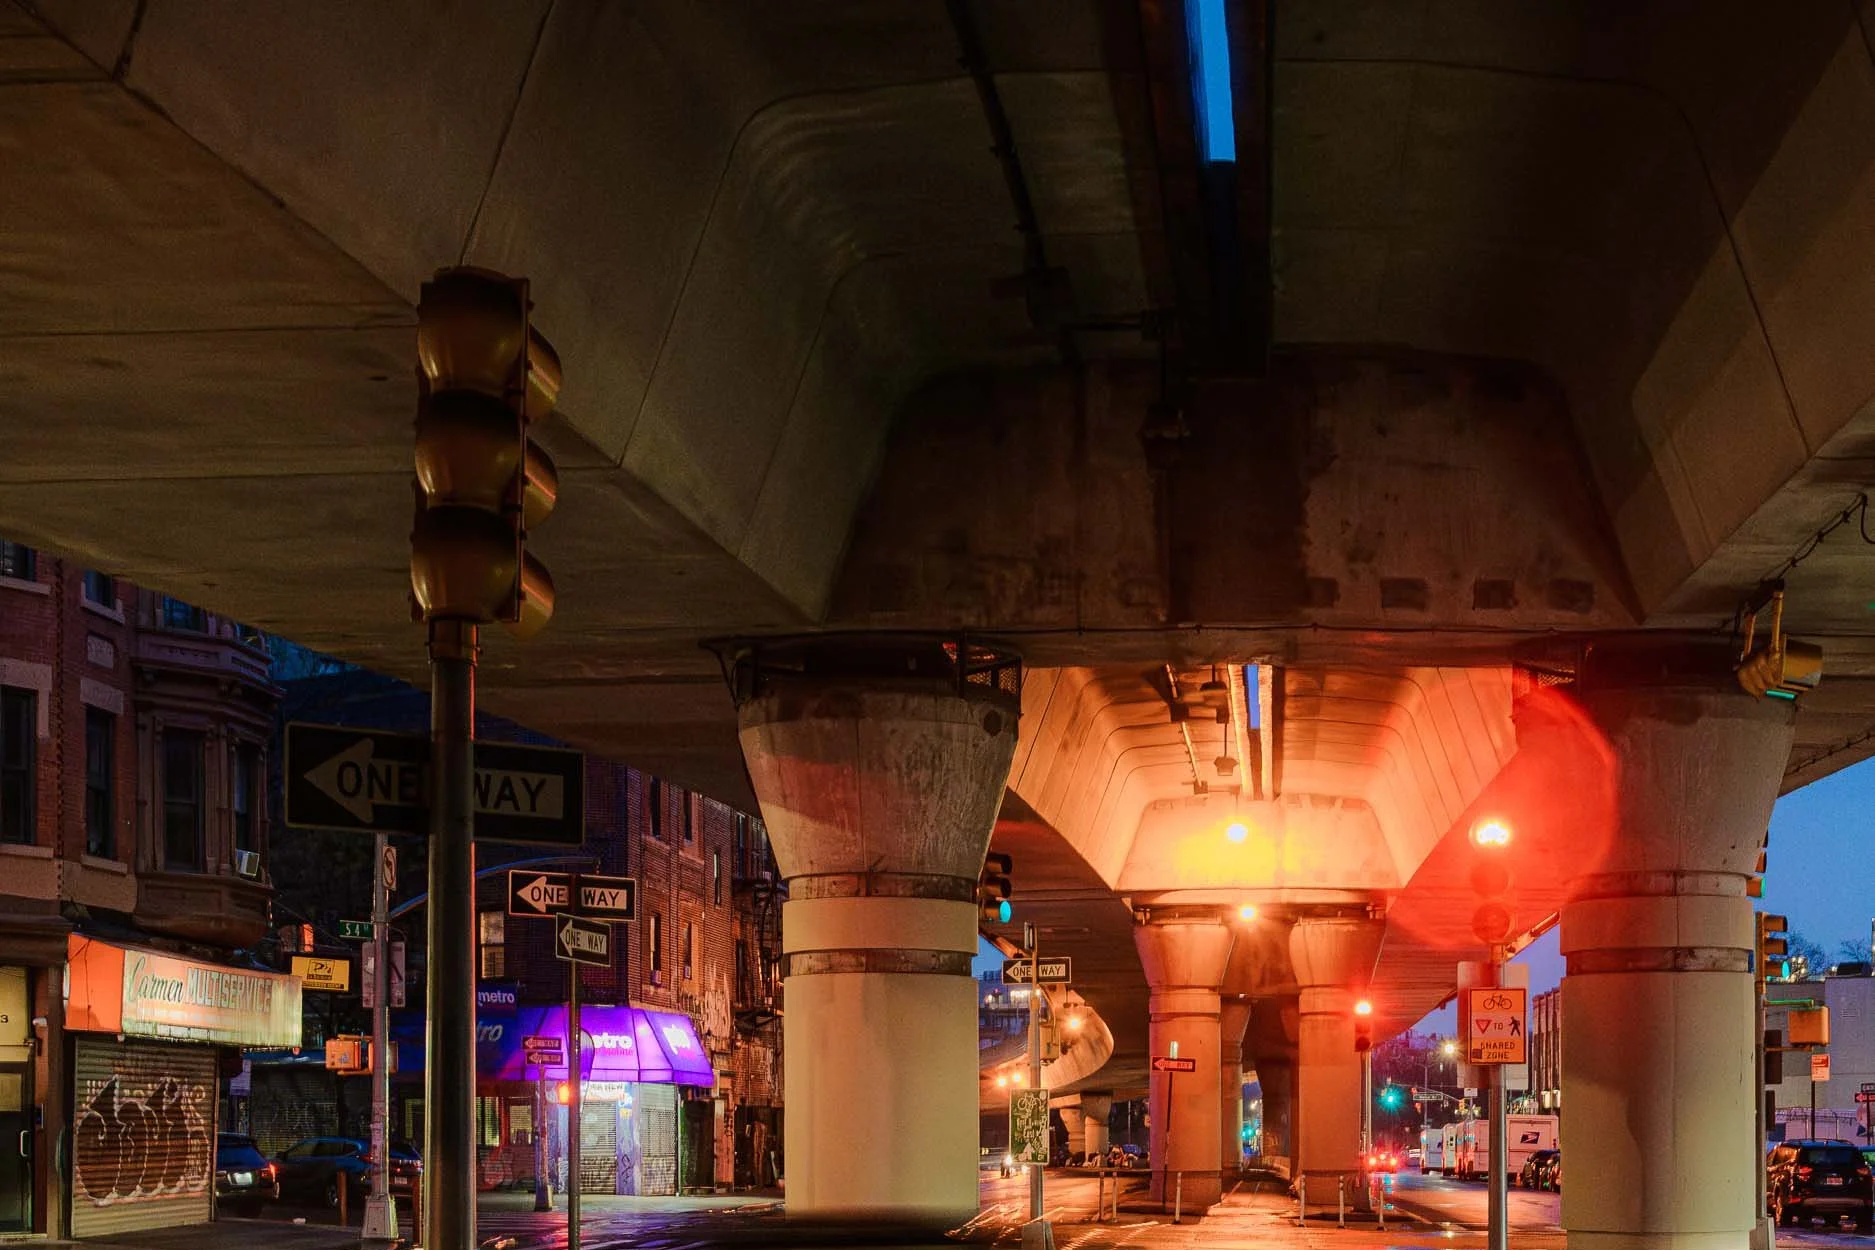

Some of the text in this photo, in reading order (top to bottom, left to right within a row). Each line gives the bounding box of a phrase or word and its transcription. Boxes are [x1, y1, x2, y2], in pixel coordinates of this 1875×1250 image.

[336, 761, 420, 802] ONE
[531, 886, 619, 907] ONE WAY
[354, 923, 360, 937] 4
[565, 929, 604, 953] ONE WAY
[1012, 965, 1062, 977] ONE WAY
[127, 956, 184, 1005] Carmen
[478, 990, 515, 1004] metro
[1493, 1022, 1504, 1031] TO
[1480, 1041, 1516, 1050] SHARED
[1486, 1051, 1511, 1060] ZONE
